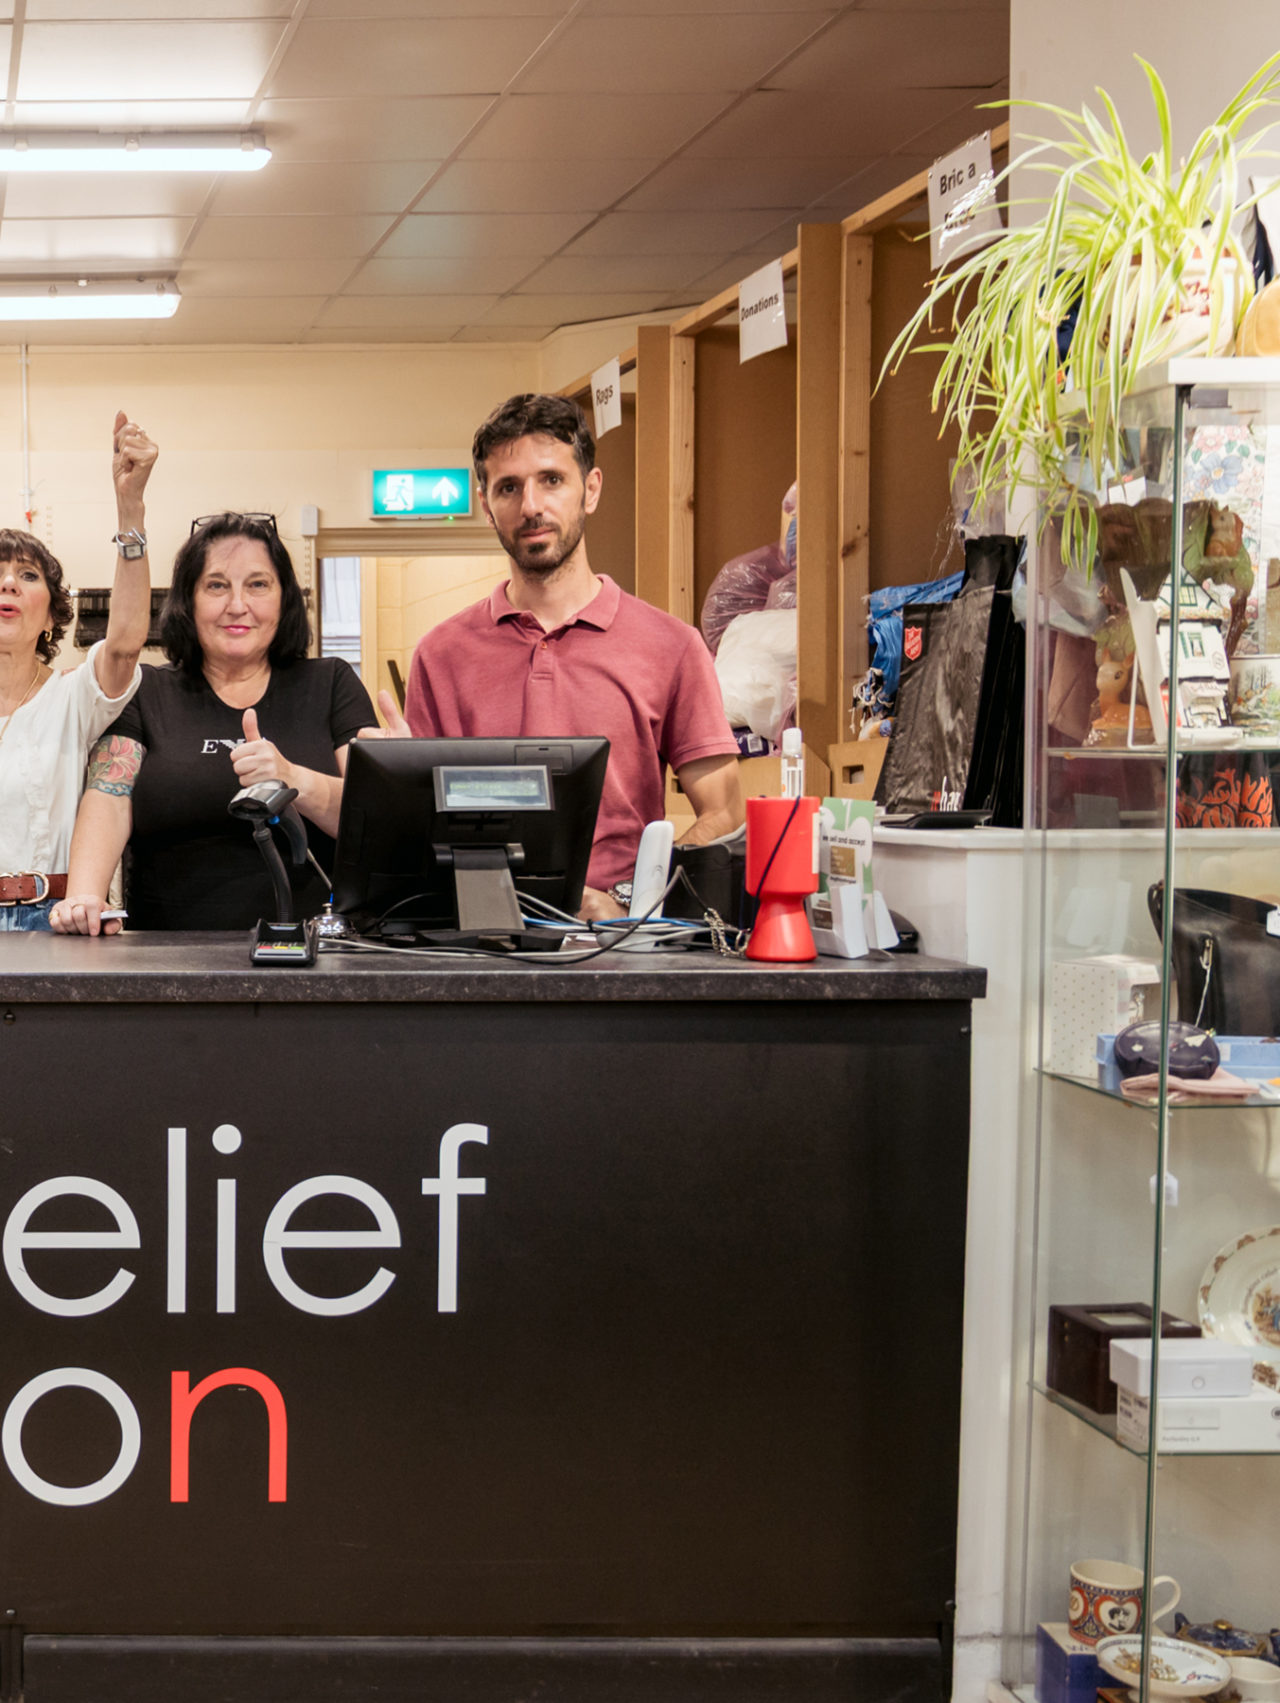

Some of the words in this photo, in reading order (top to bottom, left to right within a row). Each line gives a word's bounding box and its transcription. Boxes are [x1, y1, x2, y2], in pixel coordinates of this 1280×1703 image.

[940, 168, 964, 195] Bric
[968, 163, 976, 179] a
[741, 293, 779, 322] Donations
[596, 385, 613, 406] Rags
